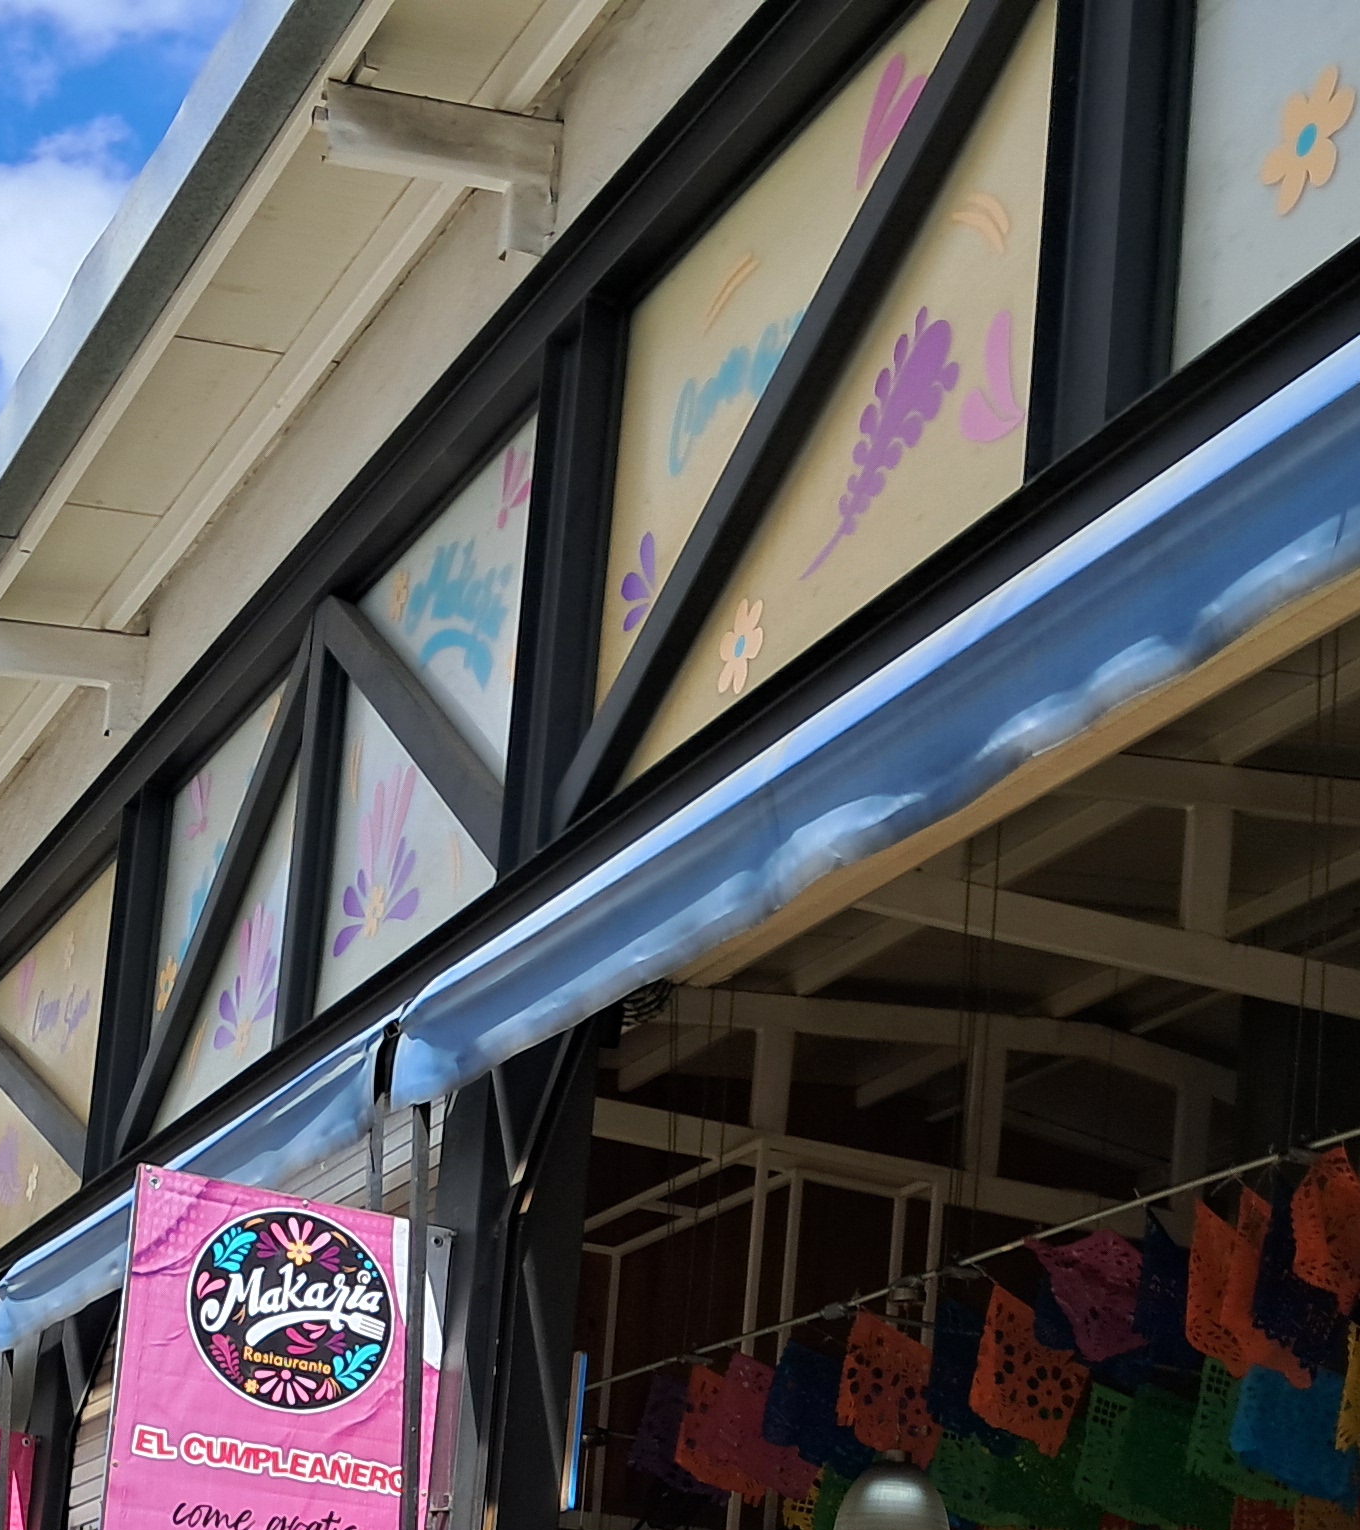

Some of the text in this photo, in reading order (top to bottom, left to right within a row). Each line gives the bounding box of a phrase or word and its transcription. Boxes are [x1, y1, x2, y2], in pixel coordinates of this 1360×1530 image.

[200, 1263, 383, 1332] Makaria
[243, 1346, 331, 1375] Restaurante
[135, 1429, 174, 1455] EL
